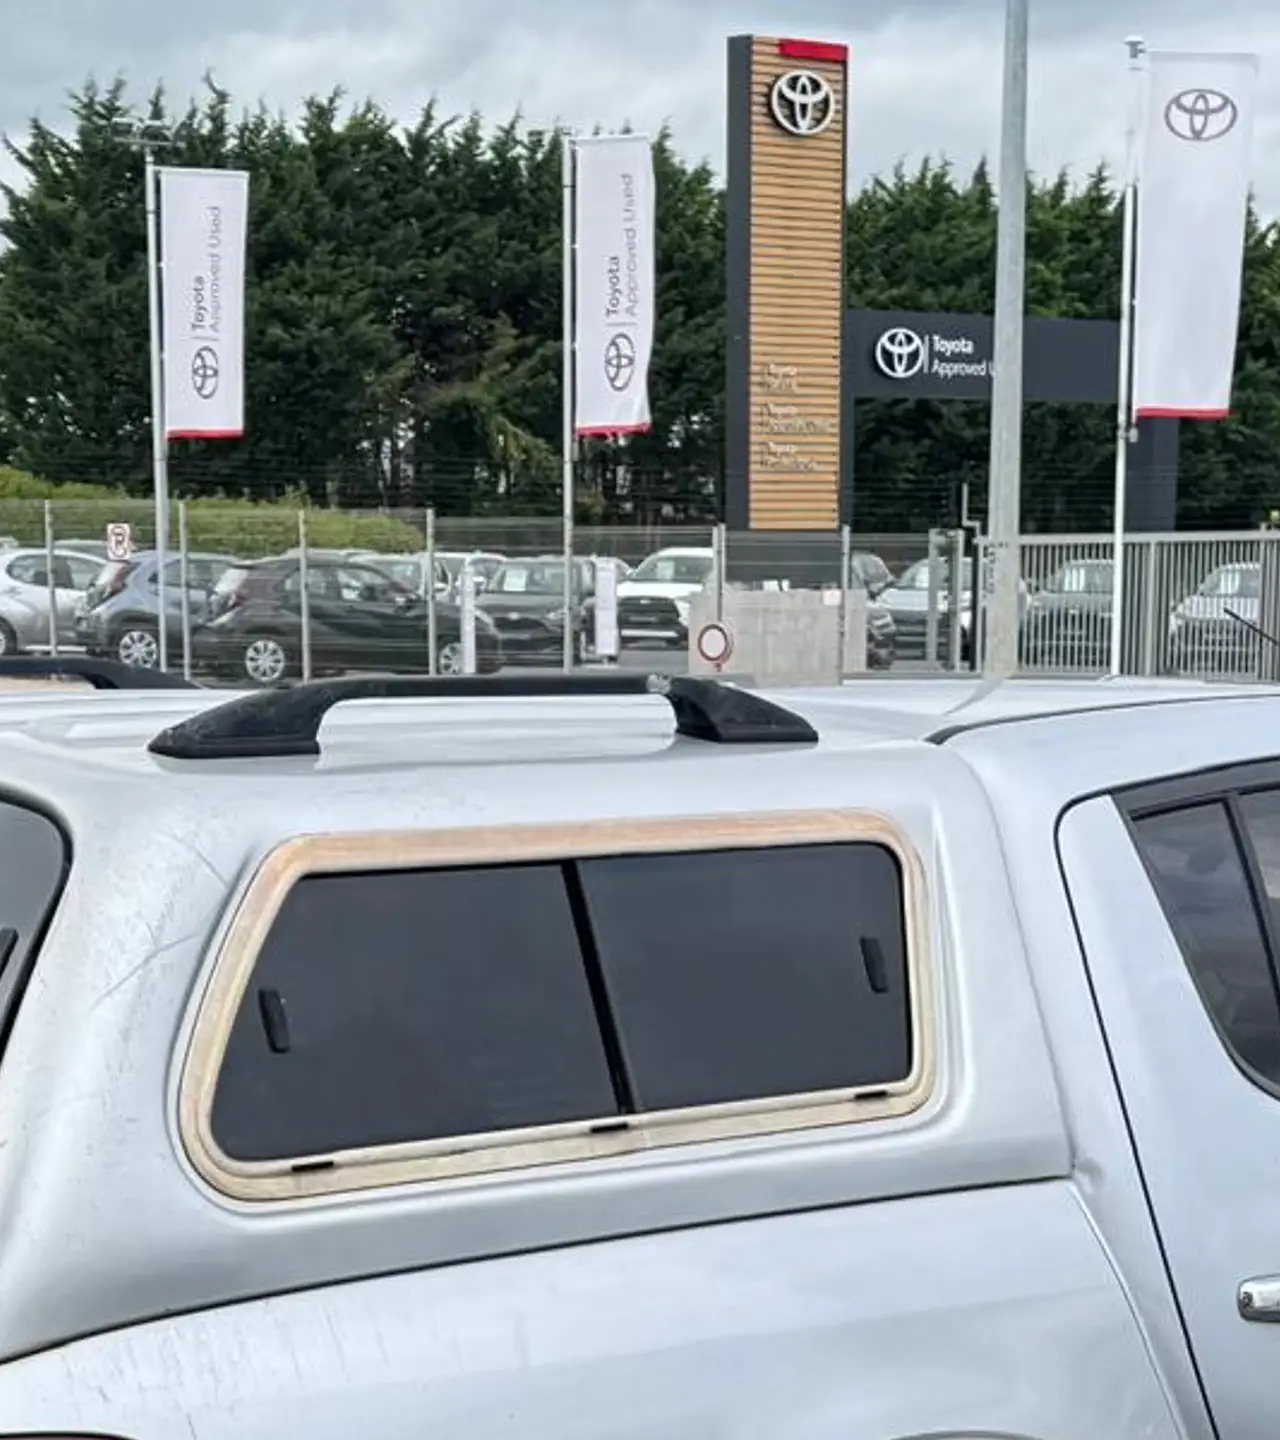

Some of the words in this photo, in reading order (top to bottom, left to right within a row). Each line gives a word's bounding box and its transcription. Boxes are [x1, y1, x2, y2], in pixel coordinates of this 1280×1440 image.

[206, 206, 222, 248] Used
[190, 275, 207, 332] Toyota
[606, 256, 622, 318] Toyota
[932, 334, 974, 356] Toyota
[931, 358, 987, 379] Approved
